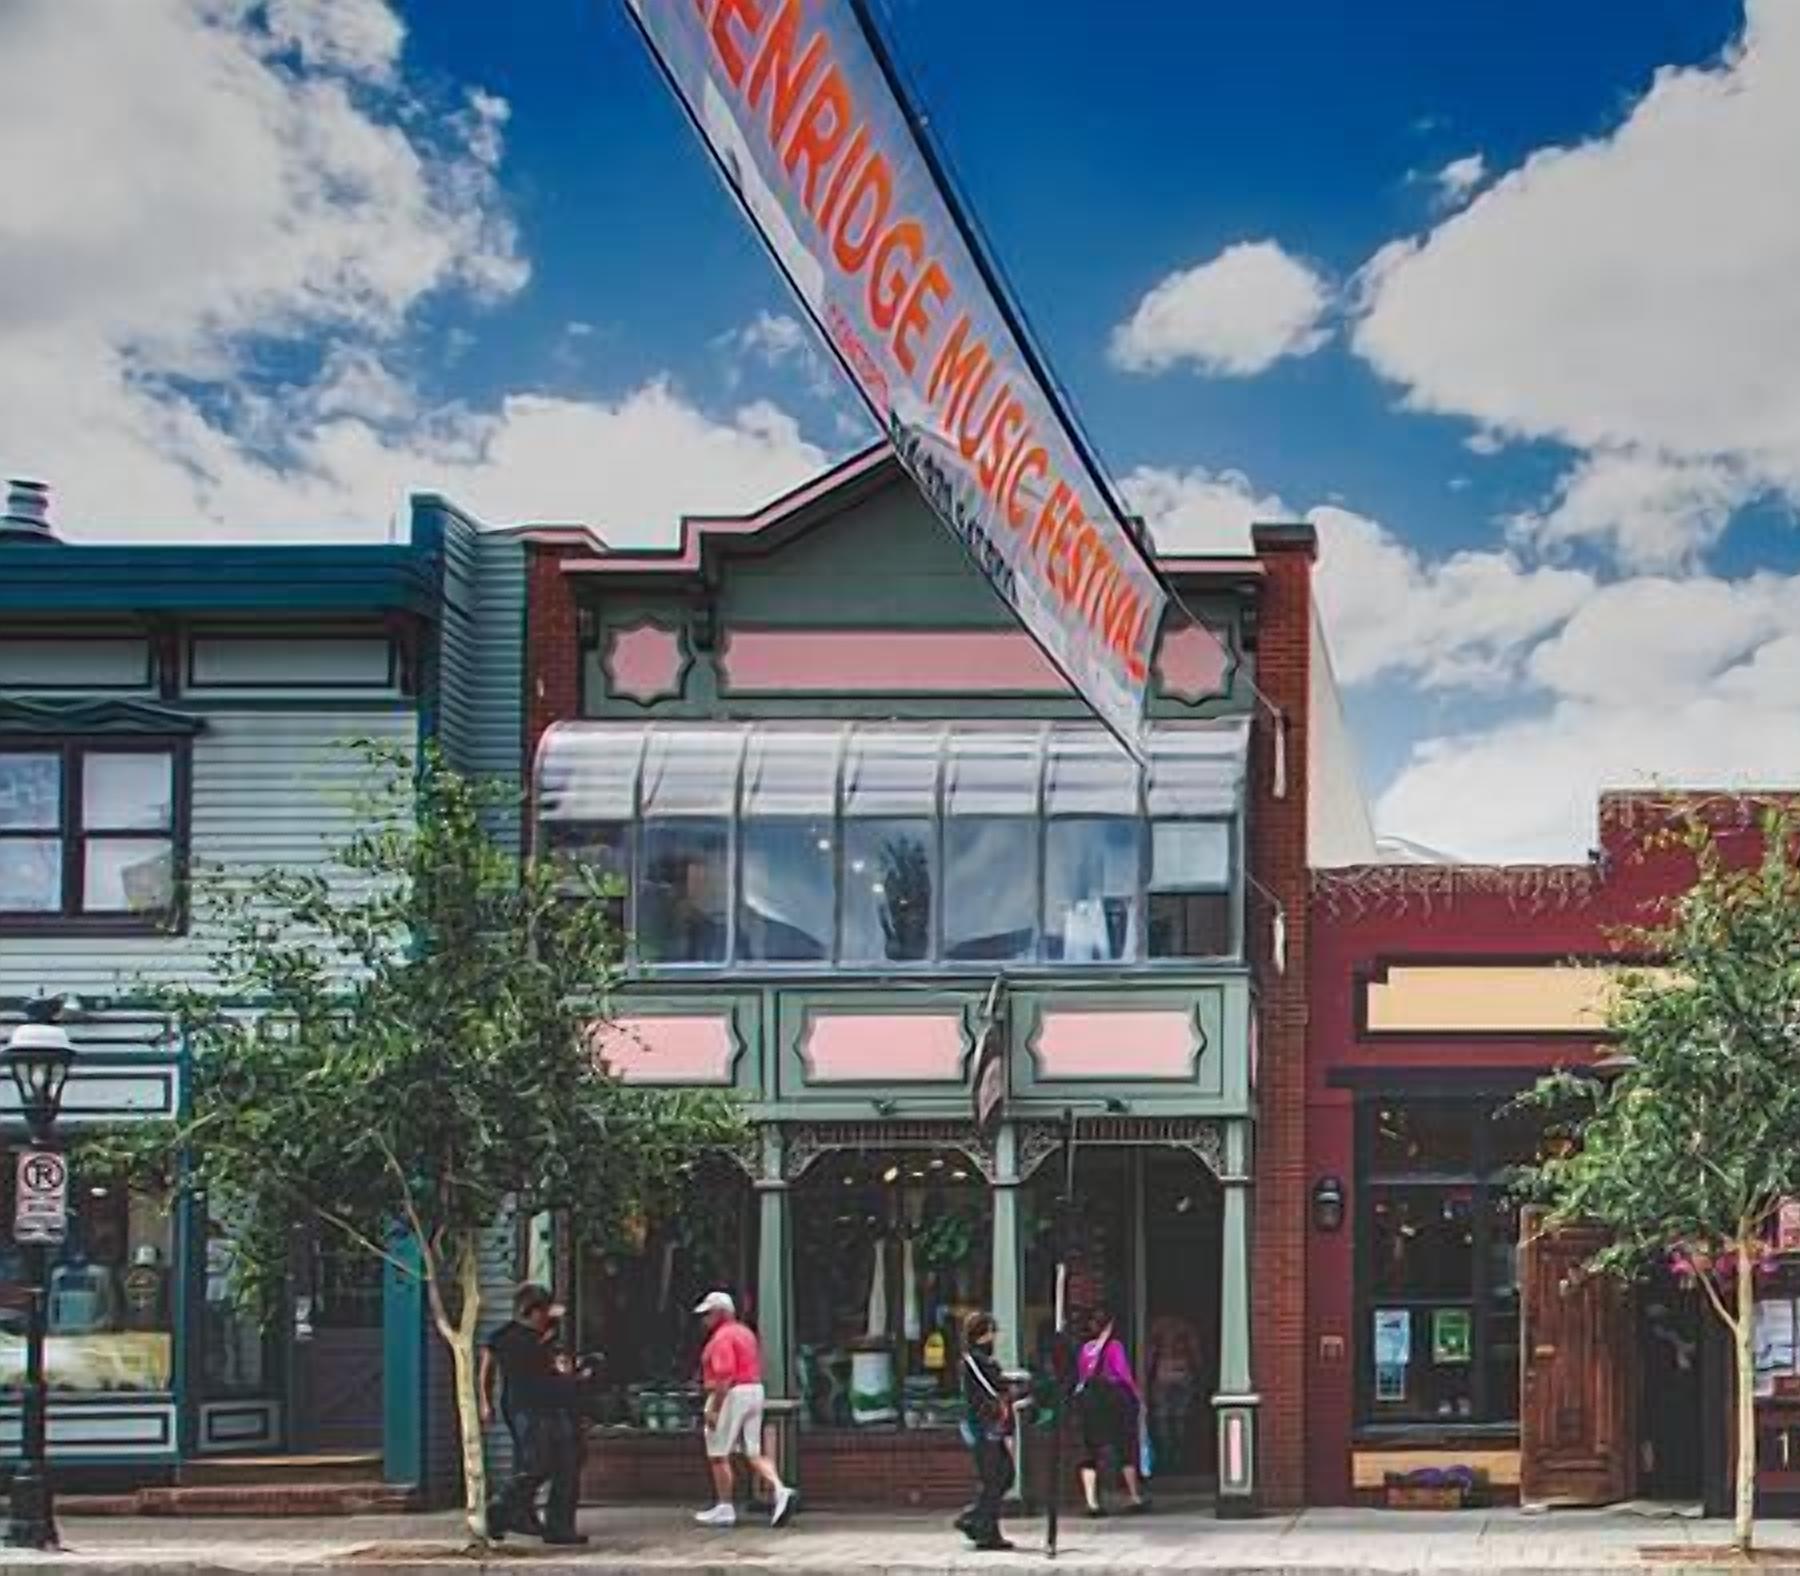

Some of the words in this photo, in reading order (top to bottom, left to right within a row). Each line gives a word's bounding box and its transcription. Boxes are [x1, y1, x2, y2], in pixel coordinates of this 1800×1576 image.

[695, 0, 953, 376] ENRIDGE
[925, 312, 1049, 530] MUSIC
[1028, 480, 1150, 682] FESTIVAL
